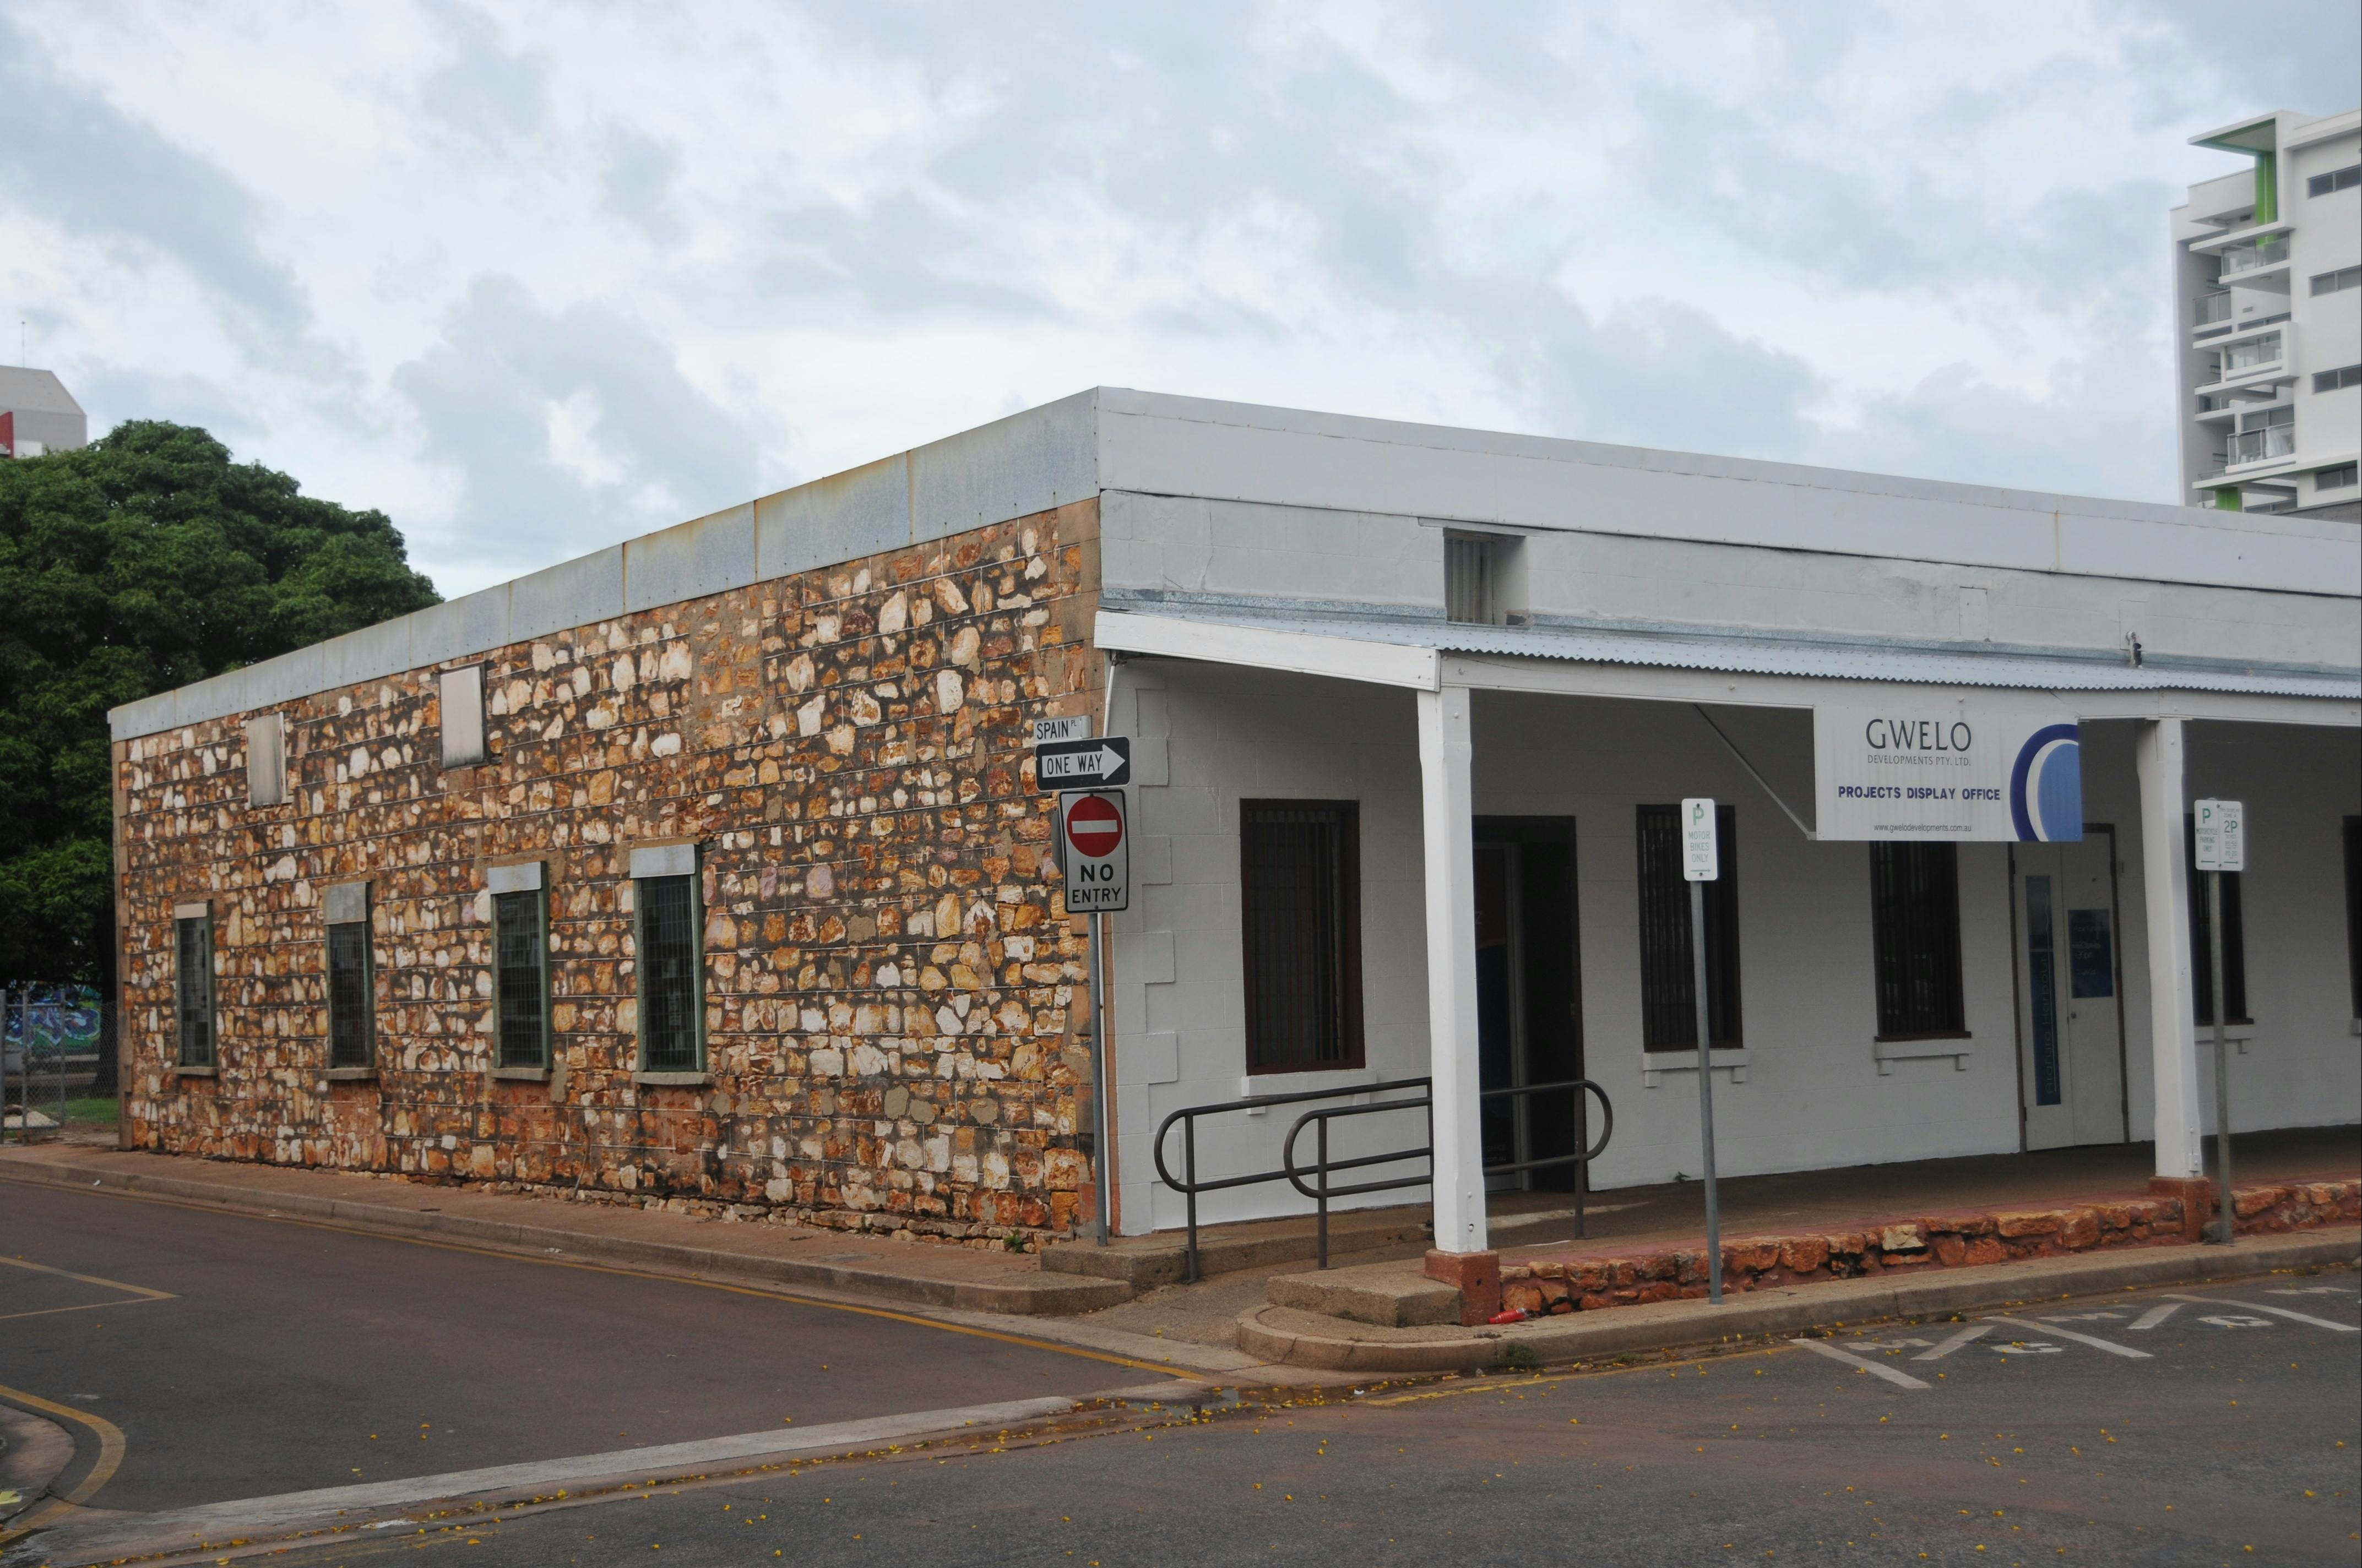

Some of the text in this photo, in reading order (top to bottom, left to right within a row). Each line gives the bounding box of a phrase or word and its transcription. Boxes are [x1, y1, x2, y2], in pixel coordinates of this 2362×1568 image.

[1036, 719, 1077, 740] SPAIN PL
[1866, 718, 1972, 752] GWELO
[1047, 753, 1102, 775] ONE WAY
[1867, 754, 1972, 766] DEVELOPMENTS PTY. LTD.
[1838, 786, 2000, 801] PROJECTS DISPLAY OFFICE
[1692, 807, 1704, 826] P
[2202, 808, 2211, 824] P
[1874, 823, 1972, 833] www.gwelodevelopments.com.au
[2224, 820, 2238, 833] 2P
[1688, 831, 1710, 840] MOTOR
[1690, 842, 1709, 851] BIKES
[1691, 854, 1708, 863] ONLY
[1080, 863, 1114, 883] NO
[1072, 887, 1122, 904] ENTRY
